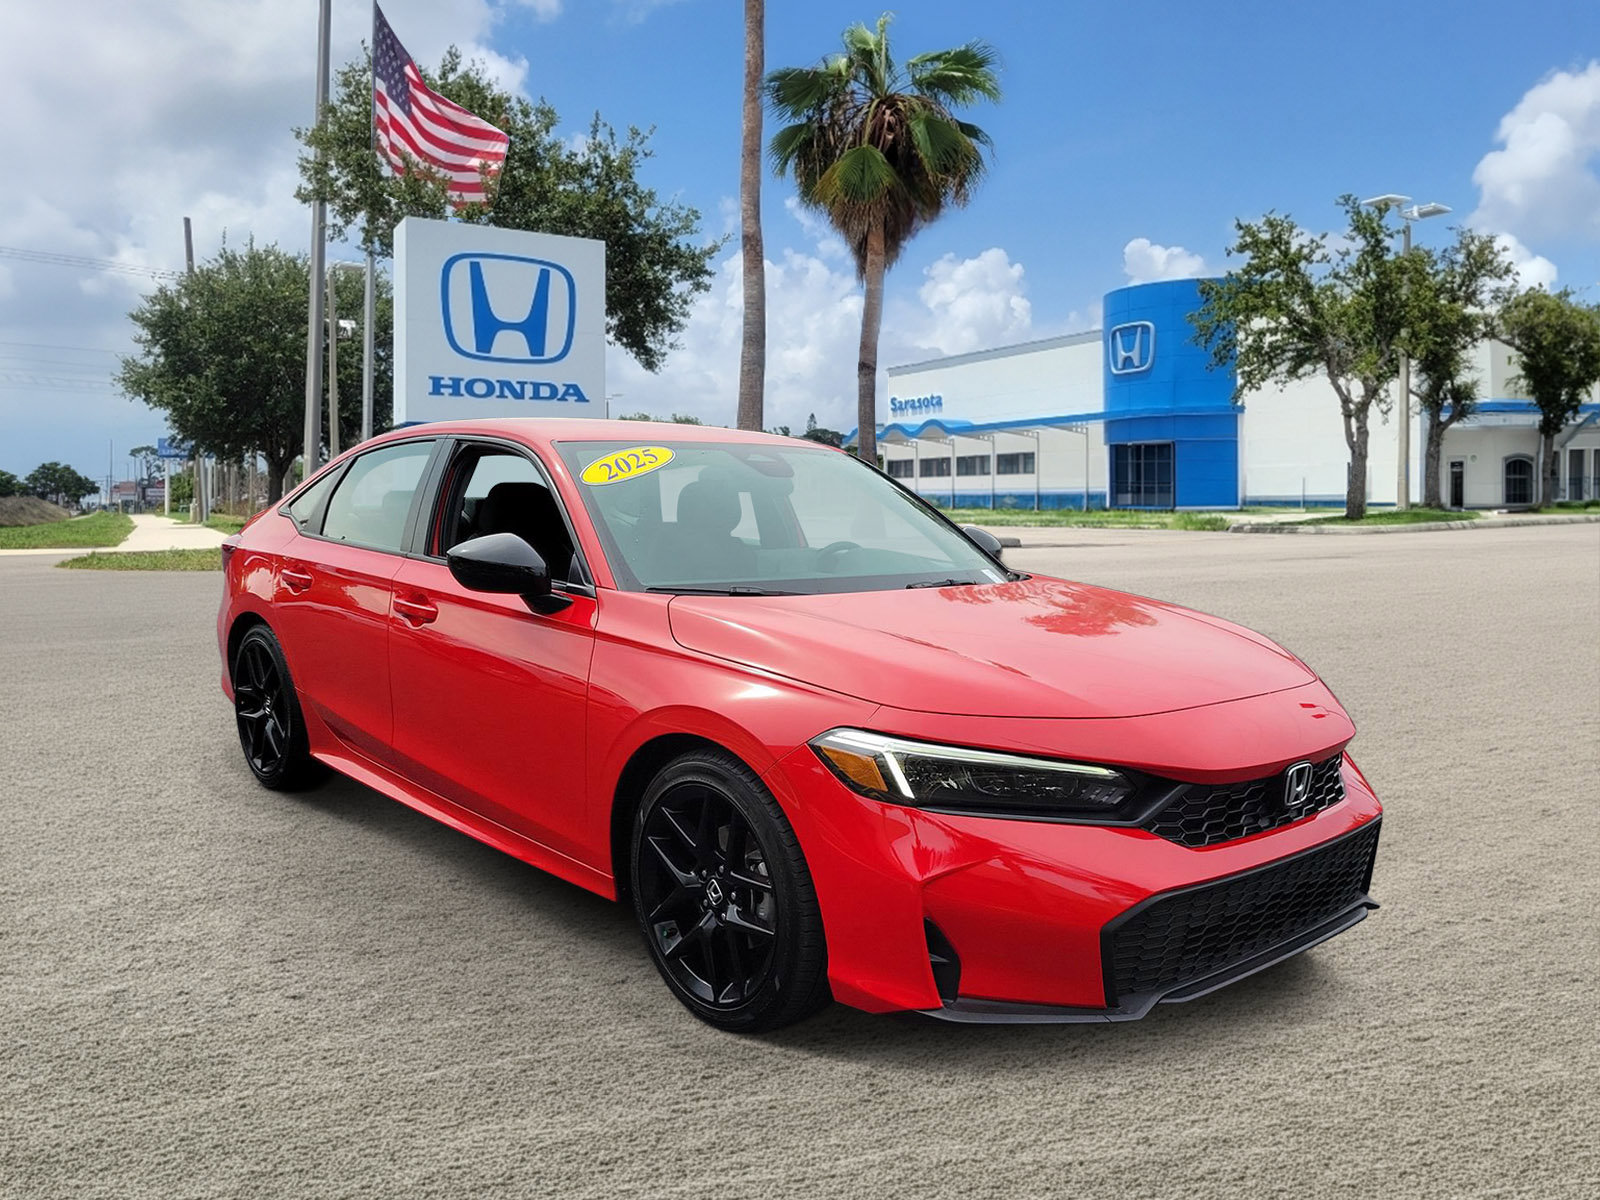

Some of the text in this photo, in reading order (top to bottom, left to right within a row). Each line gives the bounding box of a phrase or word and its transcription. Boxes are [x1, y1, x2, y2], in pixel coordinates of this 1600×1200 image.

[428, 376, 590, 403] HONDA
[890, 393, 943, 411] Sarasota
[599, 449, 658, 480] 2025
